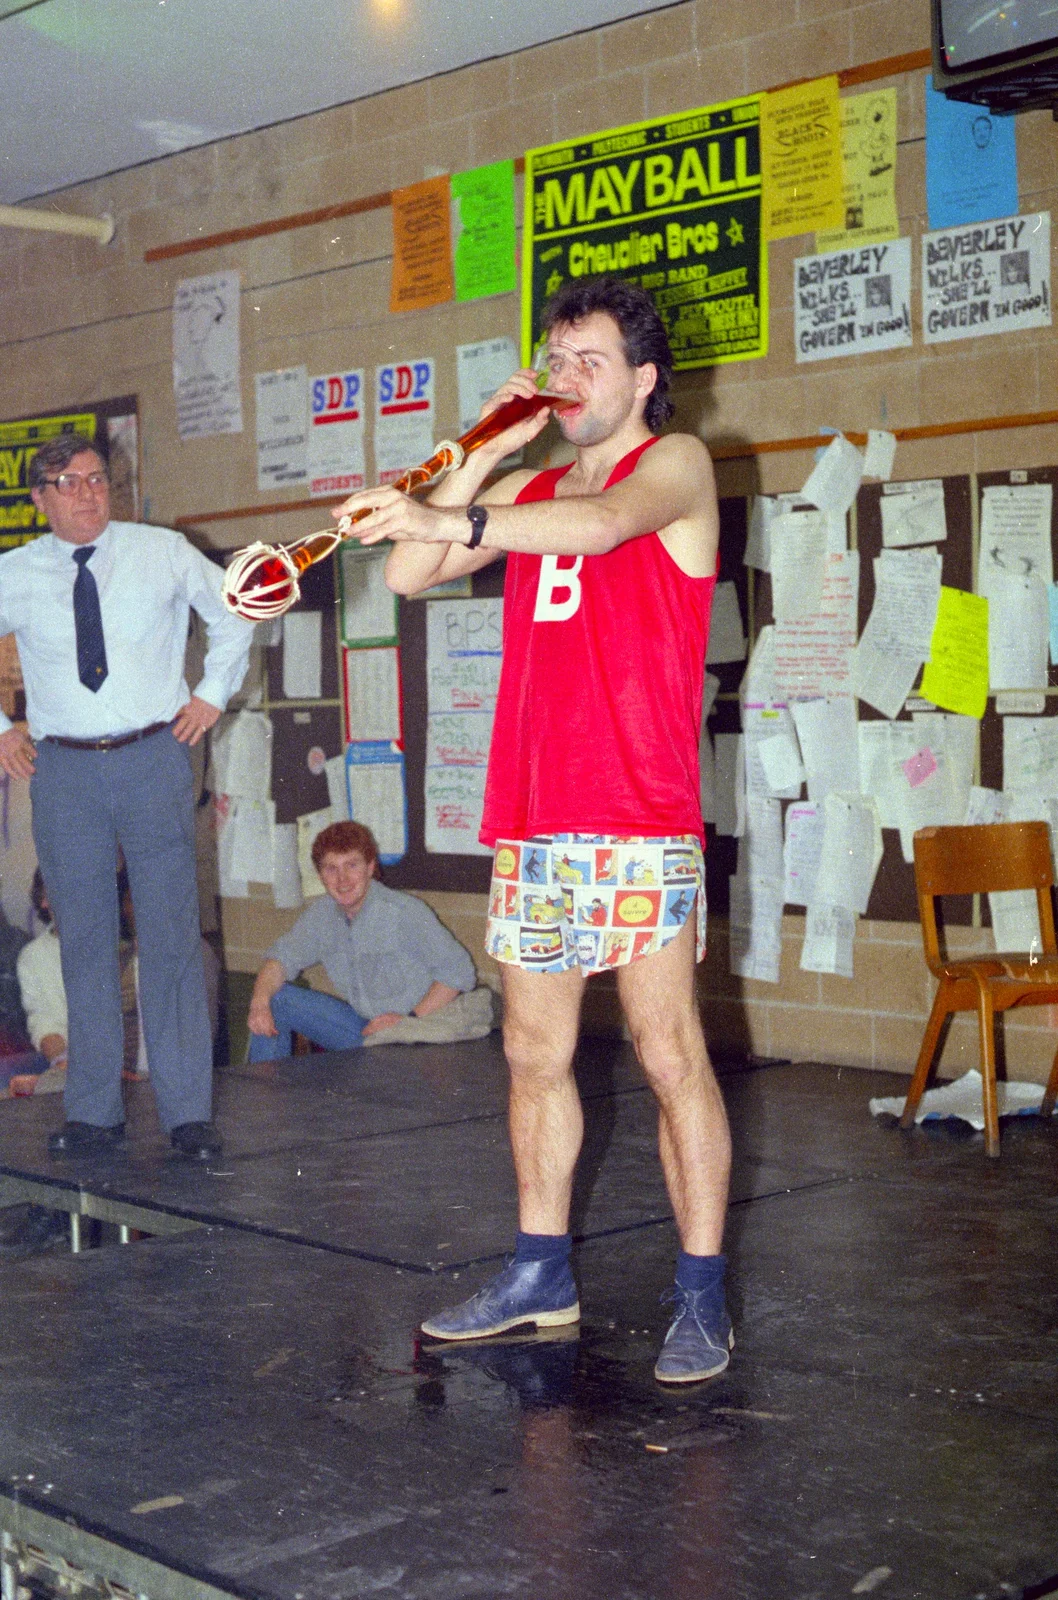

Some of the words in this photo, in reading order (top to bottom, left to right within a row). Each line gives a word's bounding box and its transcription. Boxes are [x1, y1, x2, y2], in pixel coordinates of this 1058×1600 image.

[666, 221, 719, 259] Bros
[926, 220, 1026, 265] BEVERLEY
[667, 264, 709, 284] BAND
[798, 245, 888, 288] BEVERLEY
[927, 300, 989, 334] GOVERN
[800, 322, 856, 353] GOVERN
[312, 374, 360, 413] SDP
[380, 363, 430, 403] SDP
